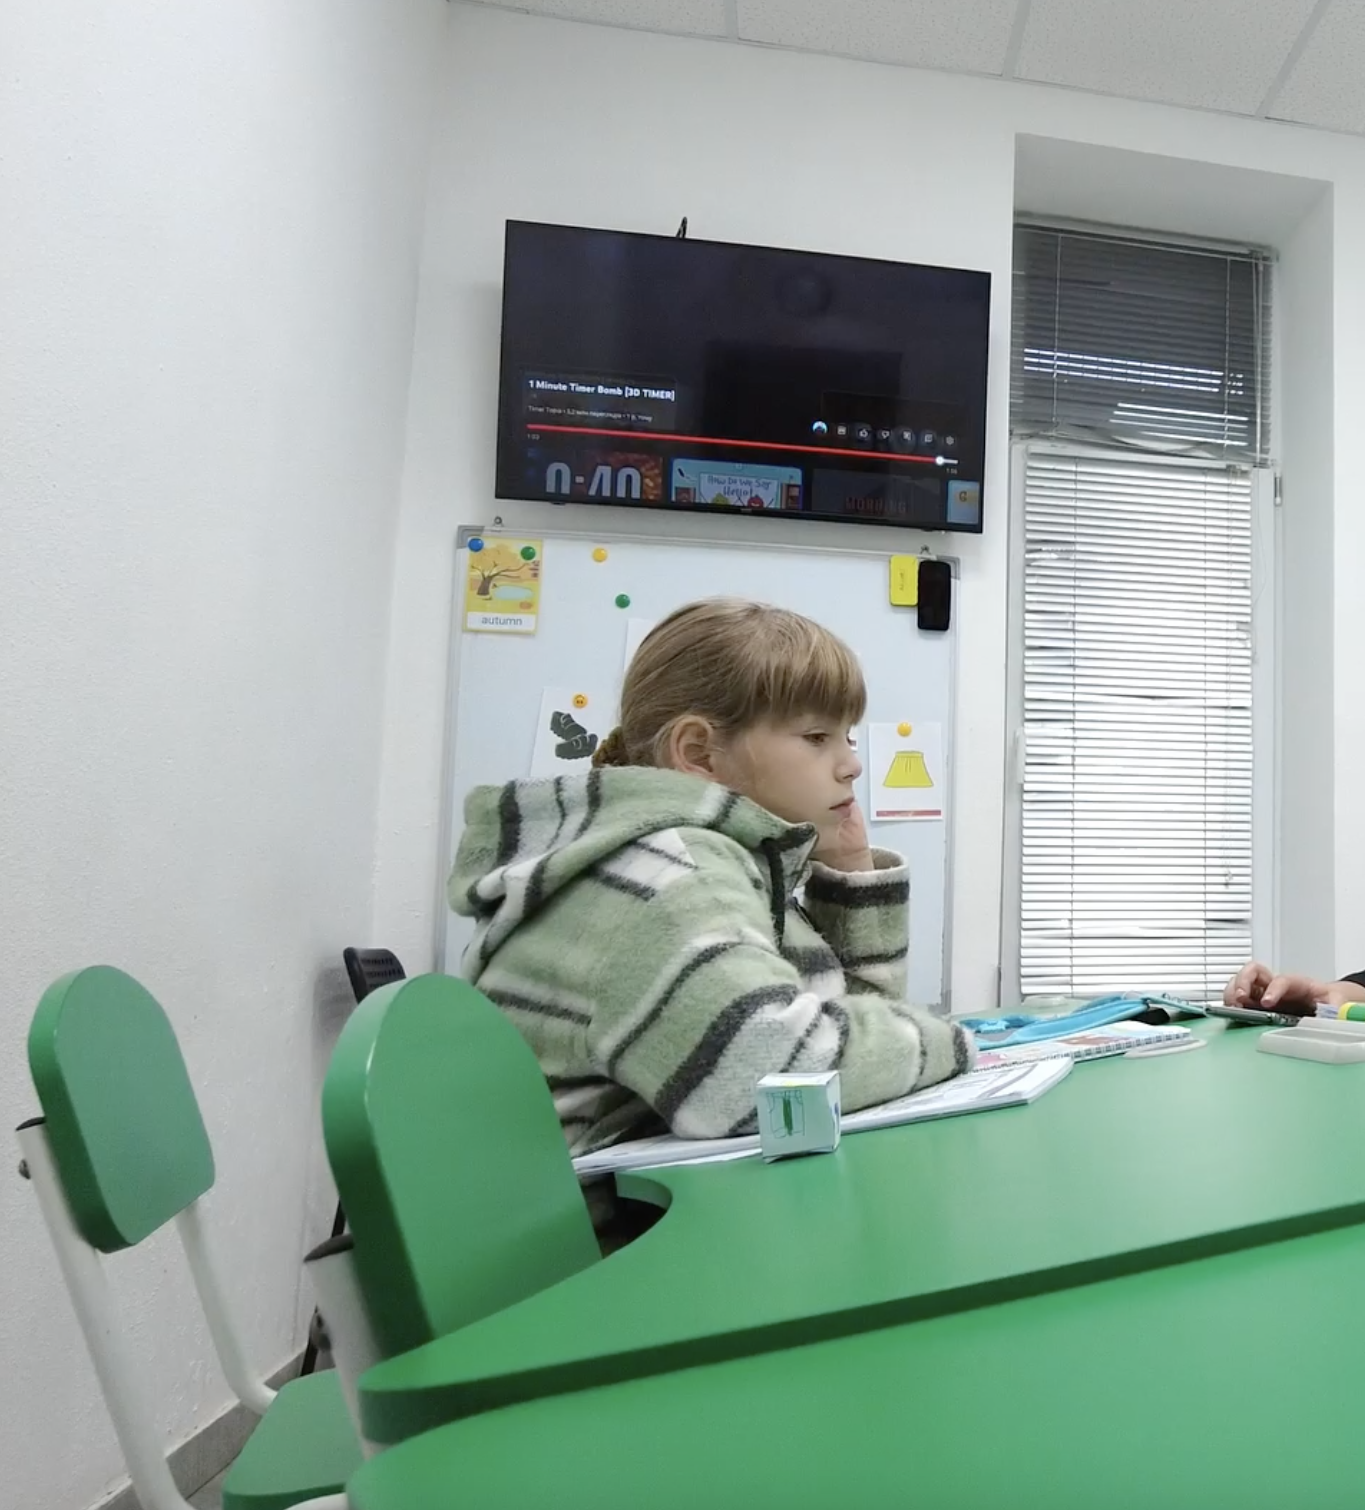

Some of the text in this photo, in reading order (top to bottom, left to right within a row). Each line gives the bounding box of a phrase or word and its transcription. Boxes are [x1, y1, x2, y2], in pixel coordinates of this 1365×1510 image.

[528, 380, 675, 402] 1 Minute Timer Bomb [3D TIMER]
[481, 616, 522, 626] autumn
